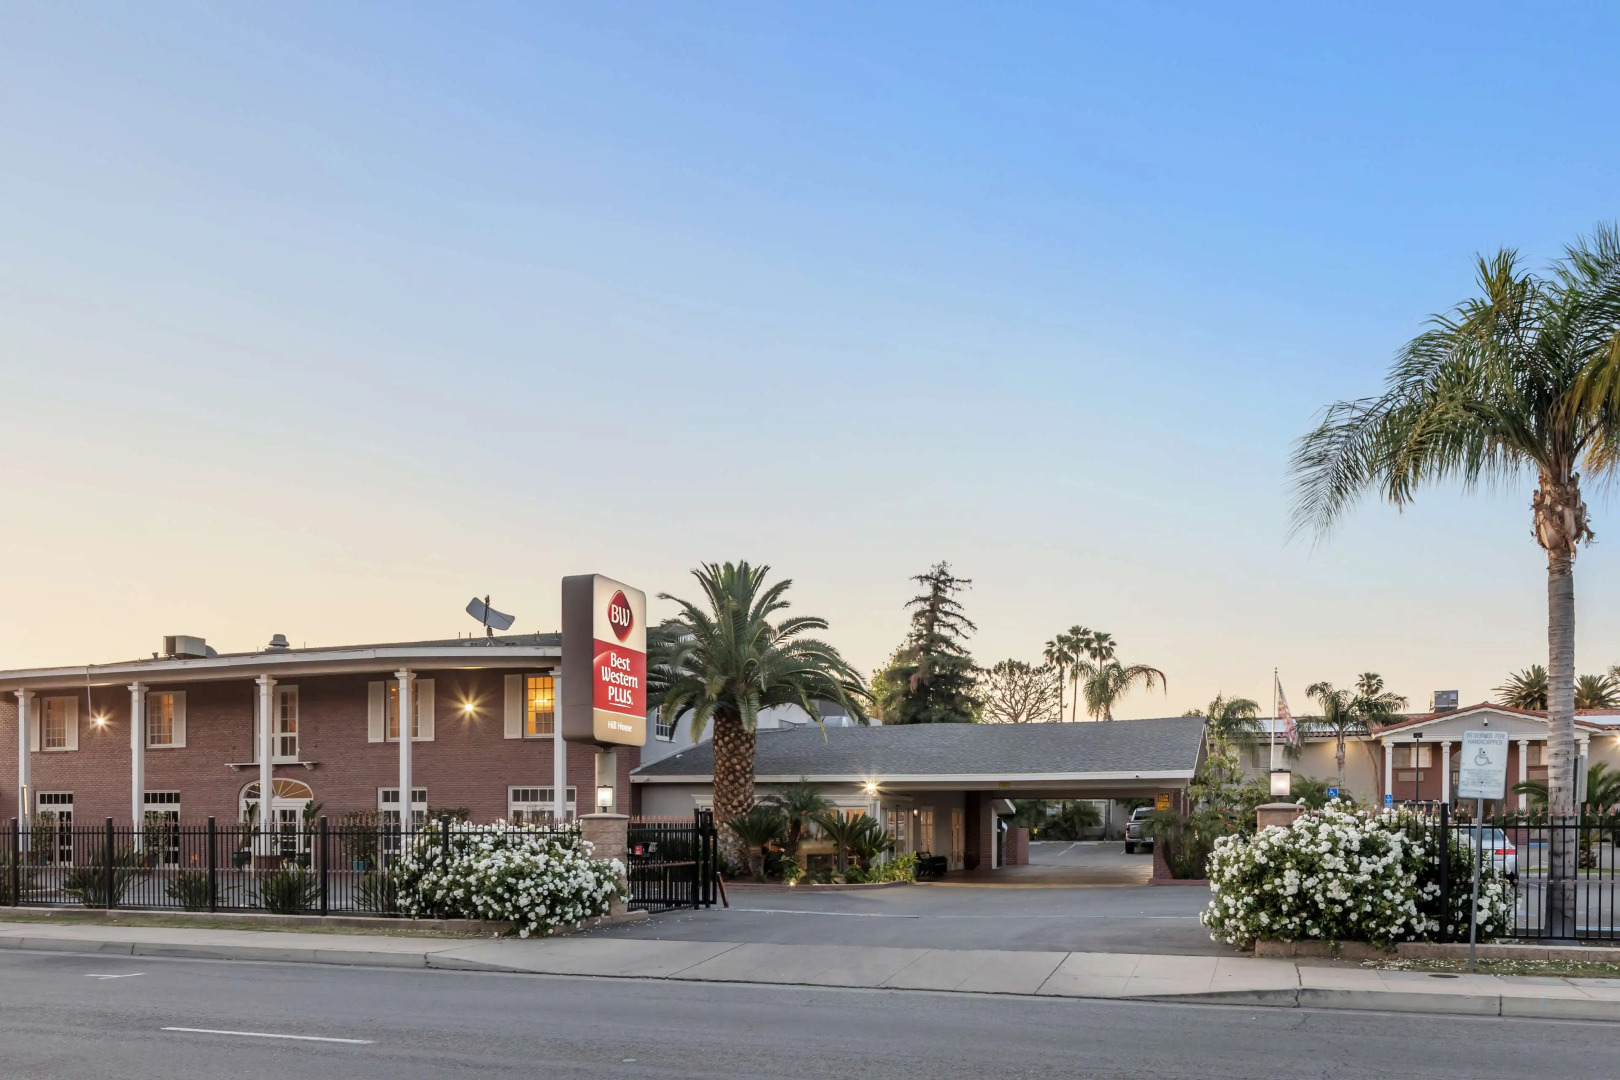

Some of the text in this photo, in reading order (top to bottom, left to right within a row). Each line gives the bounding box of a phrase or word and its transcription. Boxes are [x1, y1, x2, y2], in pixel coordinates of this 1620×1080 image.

[611, 604, 630, 627] BW
[610, 652, 631, 672] Best
[601, 666, 638, 689] Western
[607, 720, 632, 732] Hill House
